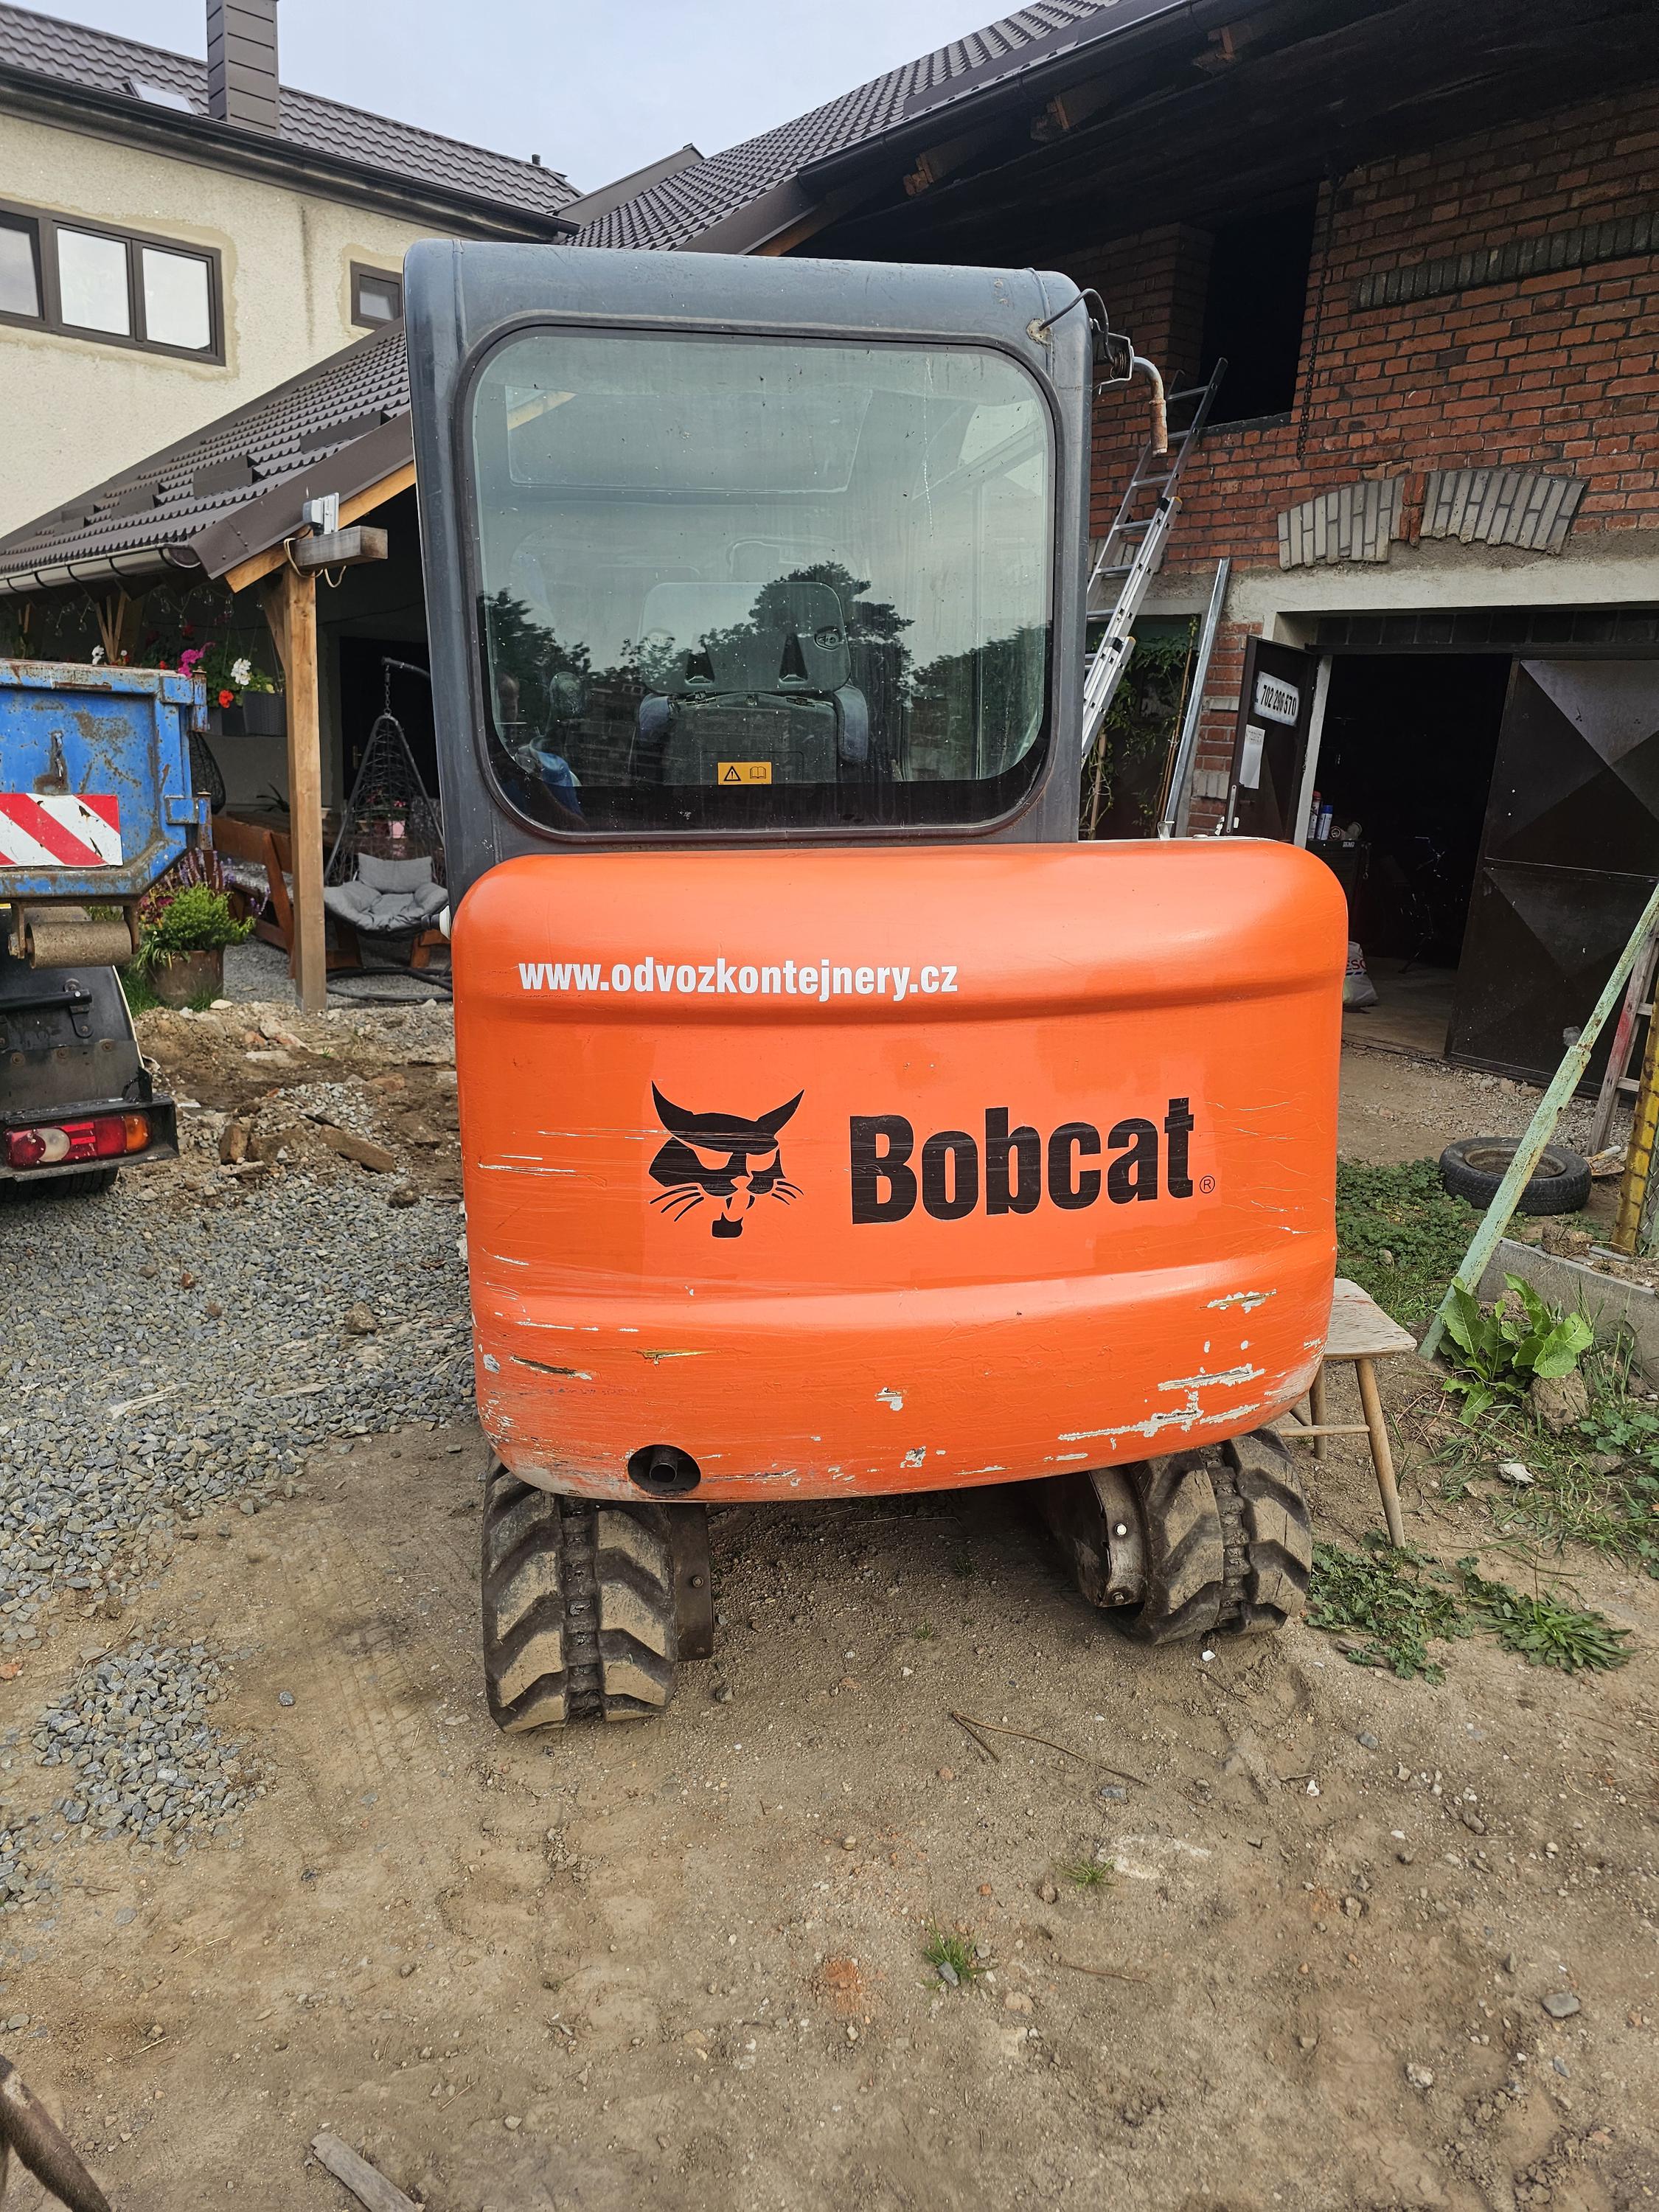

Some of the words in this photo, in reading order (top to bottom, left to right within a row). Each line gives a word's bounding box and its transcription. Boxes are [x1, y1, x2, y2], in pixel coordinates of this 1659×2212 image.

[1260, 684, 1274, 708] 702
[1284, 694, 1297, 717] 570
[518, 957, 958, 1001] www.odvozkontejnery.cz
[849, 1096, 1194, 1224] Bobcat
